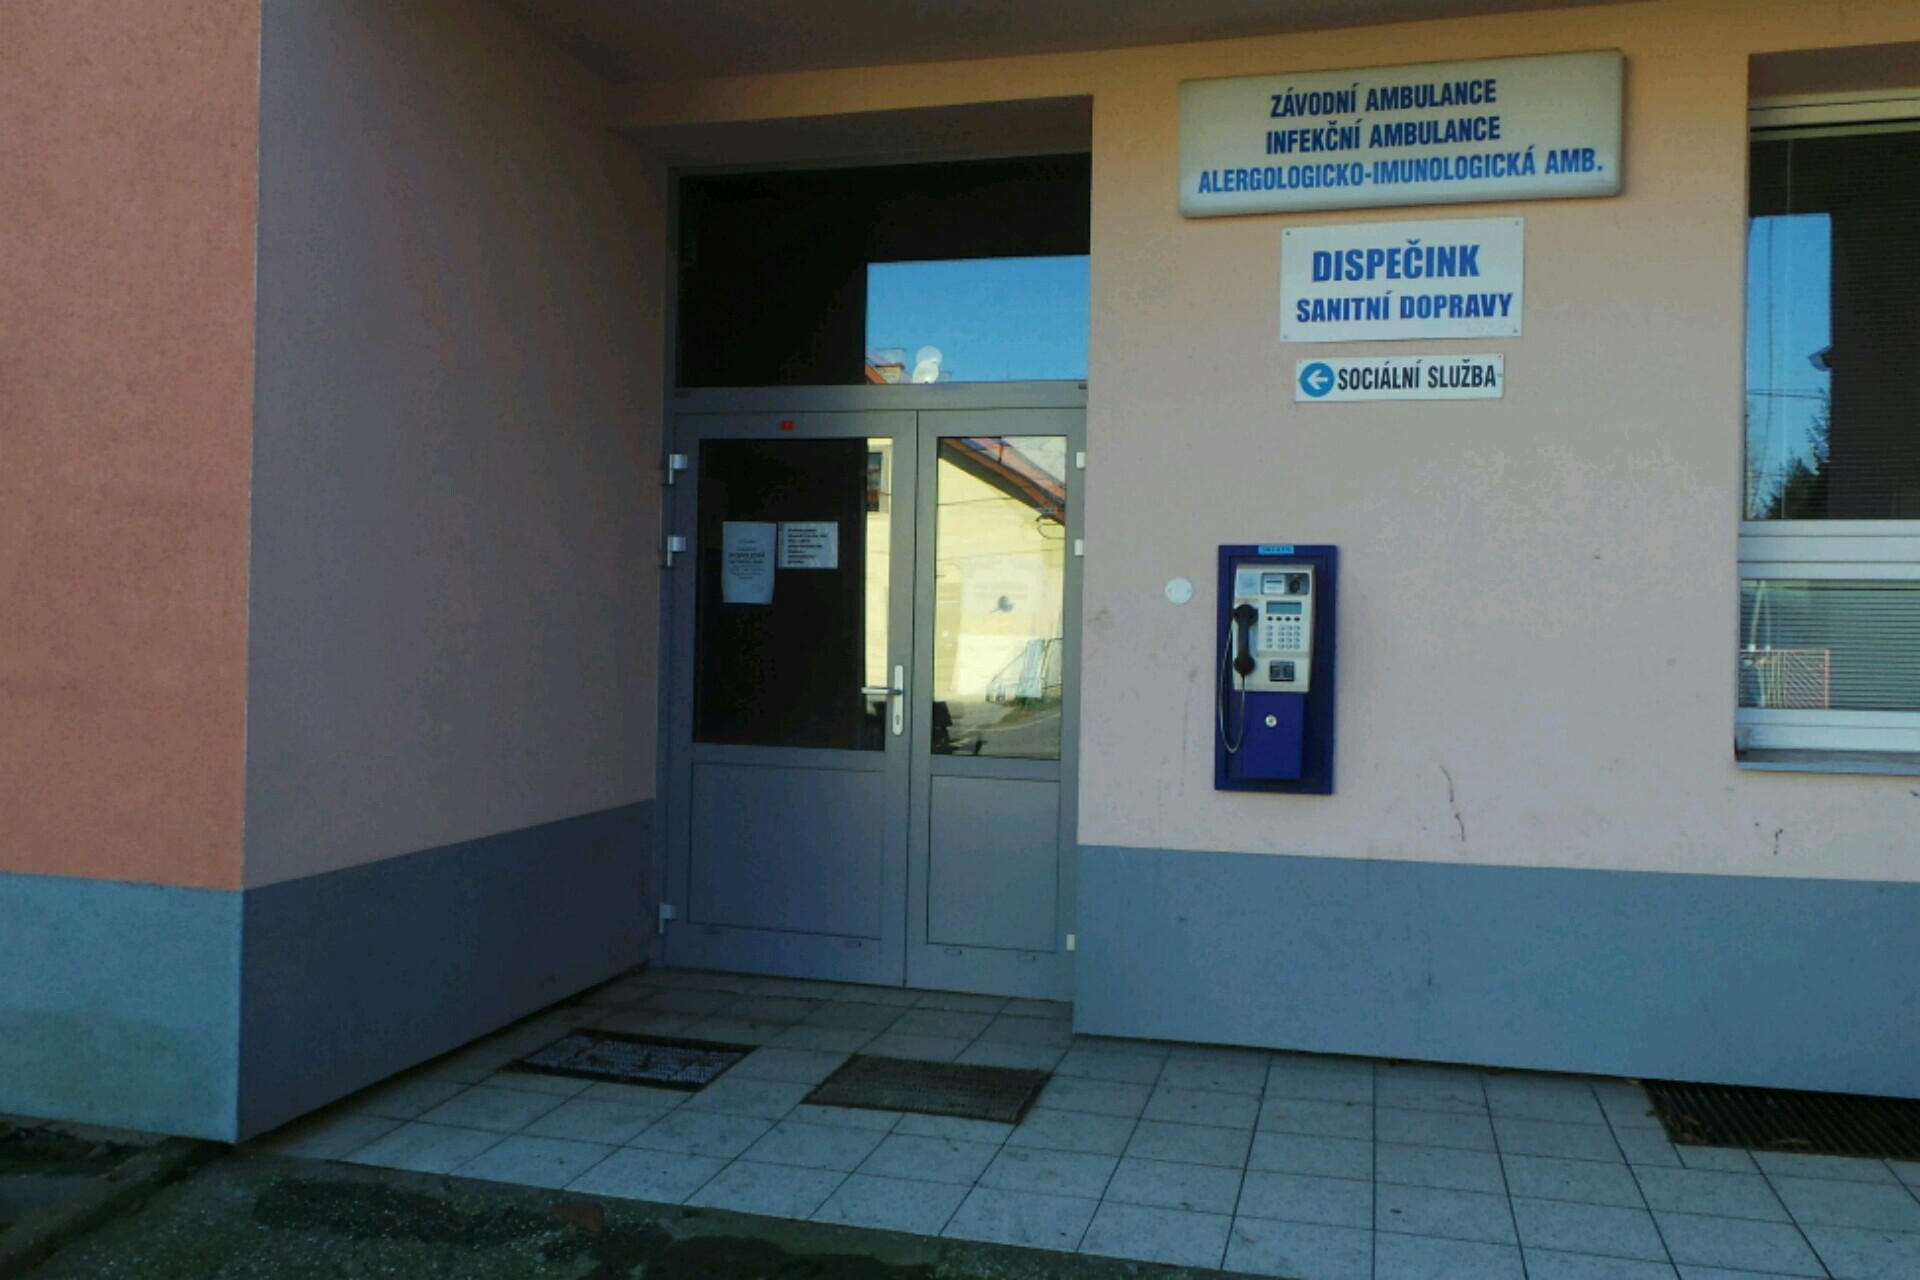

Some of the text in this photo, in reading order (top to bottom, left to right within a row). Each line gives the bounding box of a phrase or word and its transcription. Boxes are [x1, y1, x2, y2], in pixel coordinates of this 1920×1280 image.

[1271, 79, 1496, 118] ZÁVODNÍ AMBULANCE
[1266, 116, 1500, 155] INFEKČNÍ AMBULANCE
[1199, 145, 1604, 193] ALERGOLOGICKO-IMUNOLOGICKÁ AMB.
[1312, 239, 1481, 282] DISPEČINK
[1296, 291, 1513, 323] SANITNÍ DOPRAVY
[1337, 359, 1496, 390] SOCIÁLNÍ SLUŽBA
